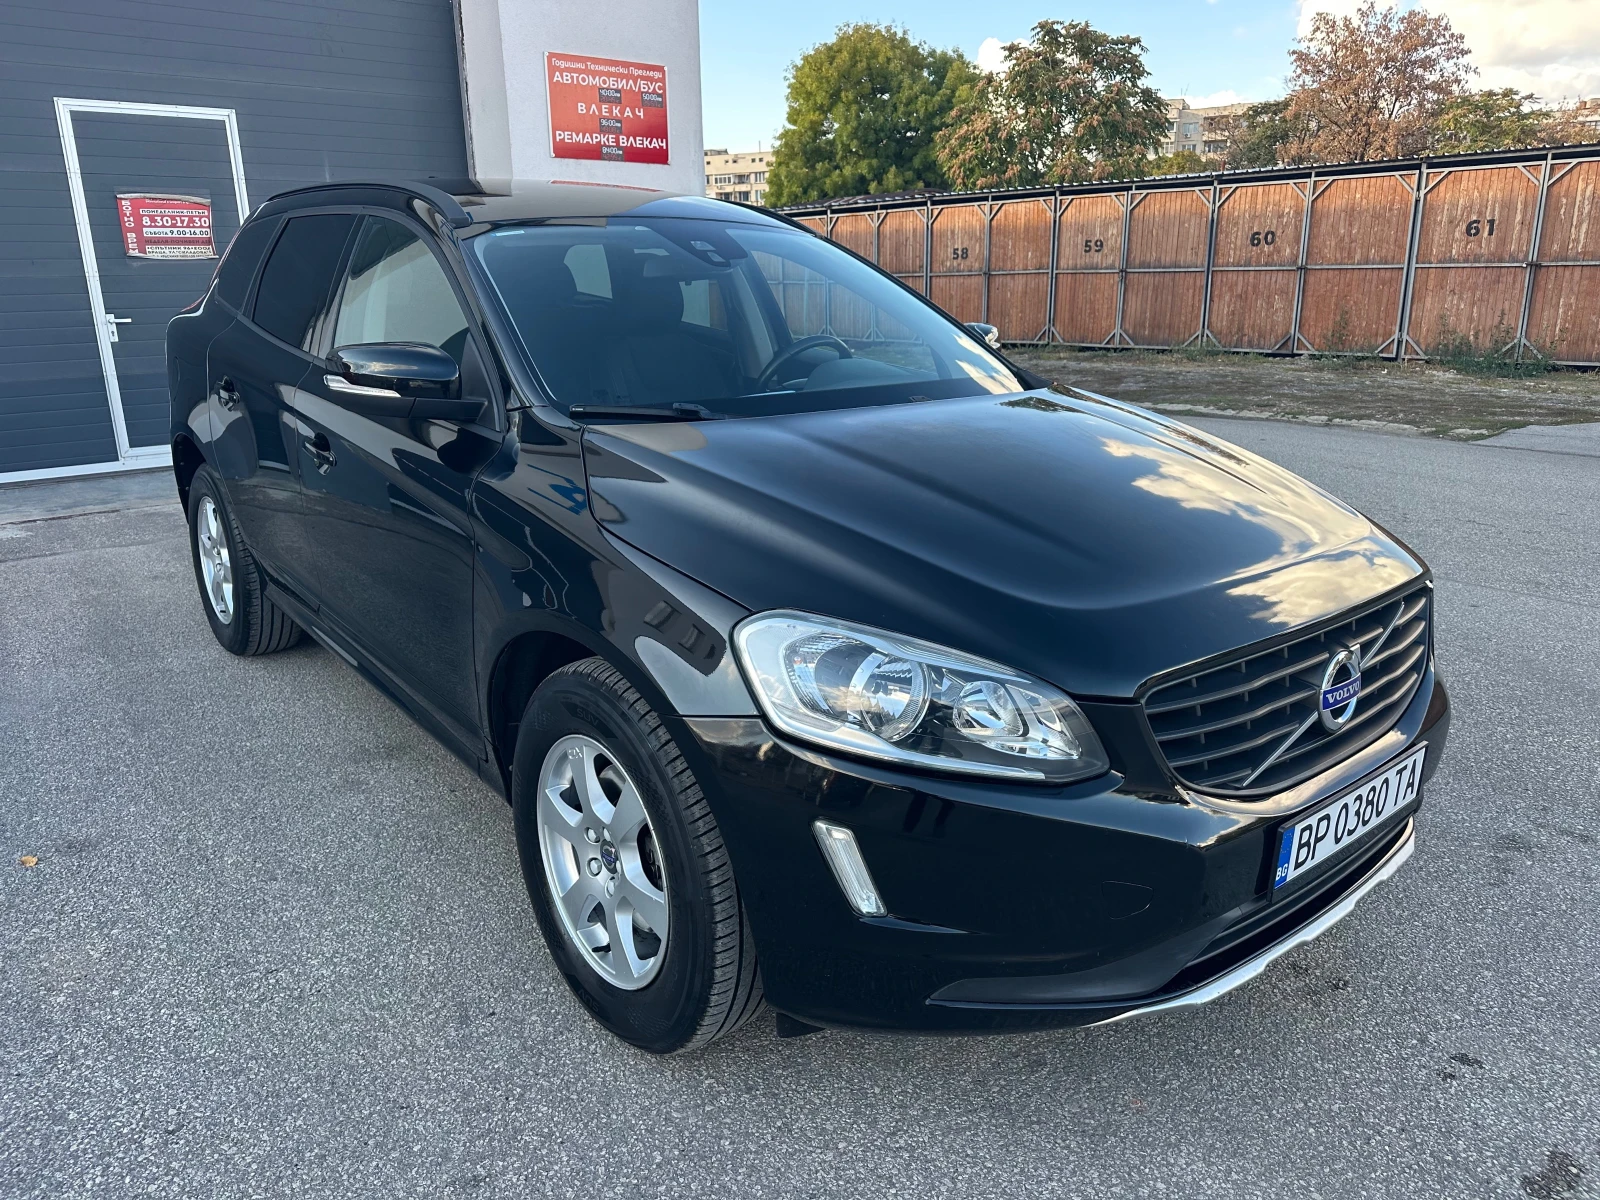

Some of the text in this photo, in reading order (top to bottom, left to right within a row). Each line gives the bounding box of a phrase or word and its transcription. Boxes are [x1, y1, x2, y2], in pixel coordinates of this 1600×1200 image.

[552, 58, 662, 79] Годишни Технически Прегледи
[553, 71, 663, 93] АВТОМОБИЛ/БУС
[555, 130, 666, 149] РЕМАРКЕ ВЛЕКАЧ
[142, 216, 209, 227] 8.30-17.30
[1465, 218, 1496, 237] 61
[1083, 239, 1104, 253] 59
[1249, 230, 1276, 247] 60
[952, 247, 969, 260] 58
[1325, 680, 1360, 704] VOLVO
[1293, 757, 1417, 871] BP 0380 TA
[1275, 862, 1289, 881] BG
